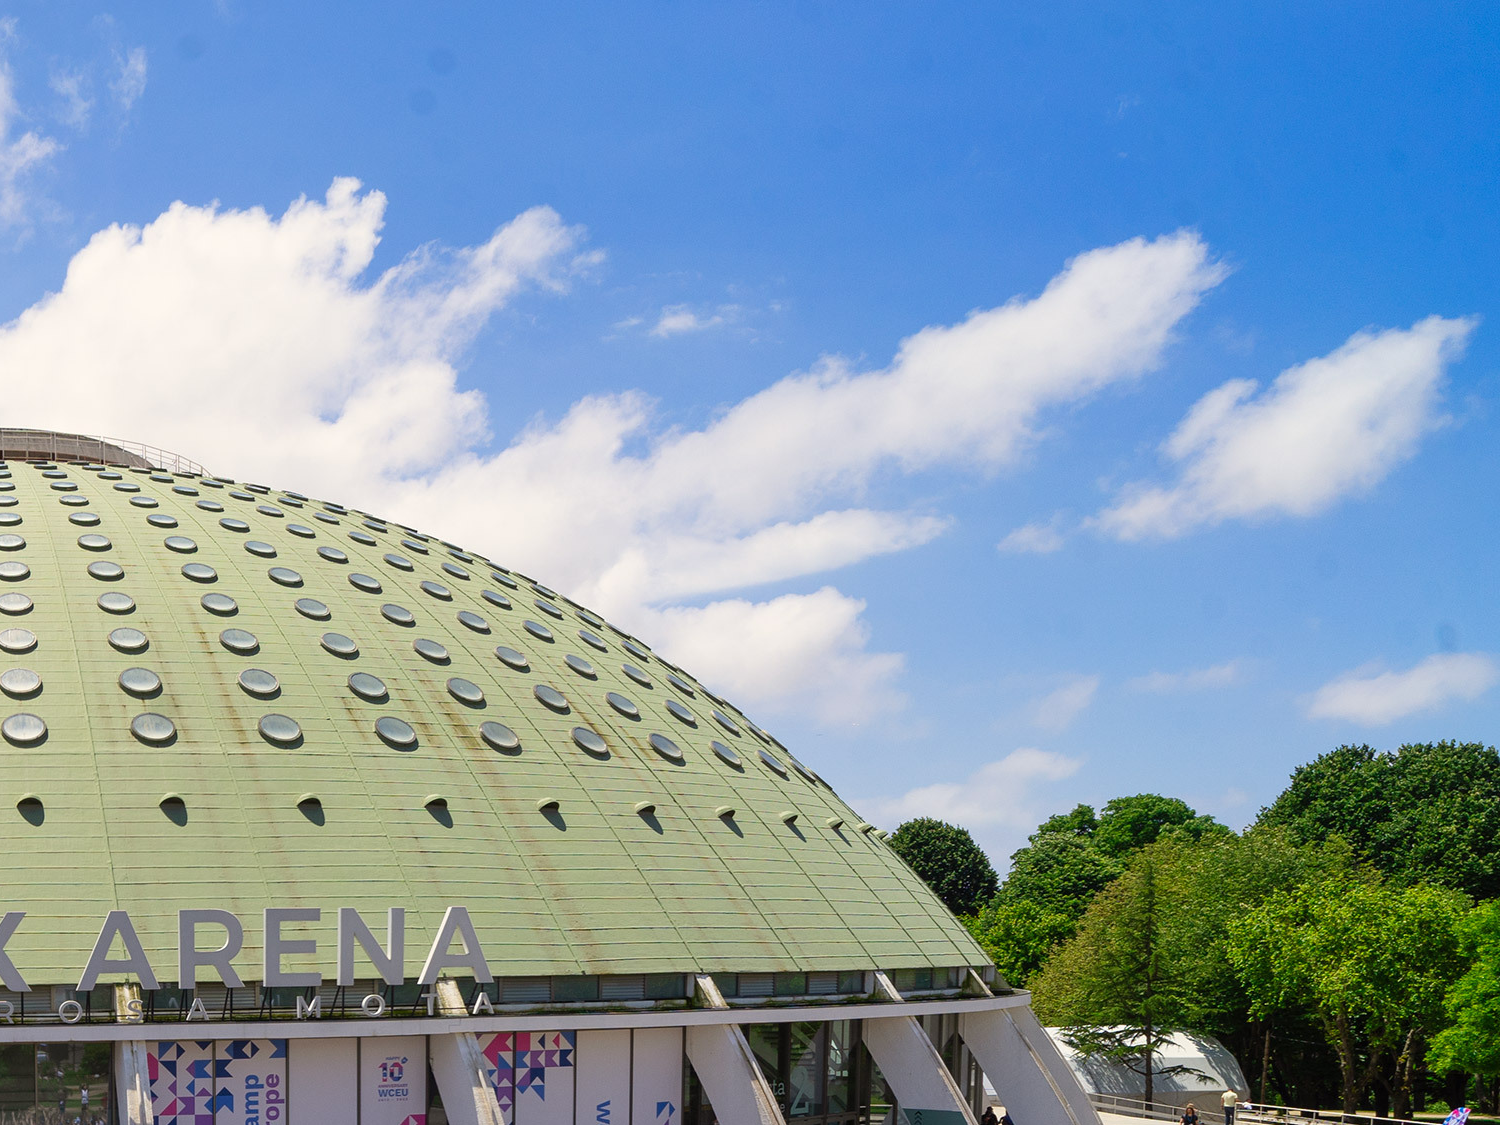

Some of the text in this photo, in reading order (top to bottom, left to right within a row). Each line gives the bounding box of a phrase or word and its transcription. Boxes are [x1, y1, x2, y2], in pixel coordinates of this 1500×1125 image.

[76, 905, 495, 992] ARENA
[296, 992, 496, 1020] MOTA
[378, 1062, 404, 1082] 10
[378, 1088, 409, 1097] WCEU
